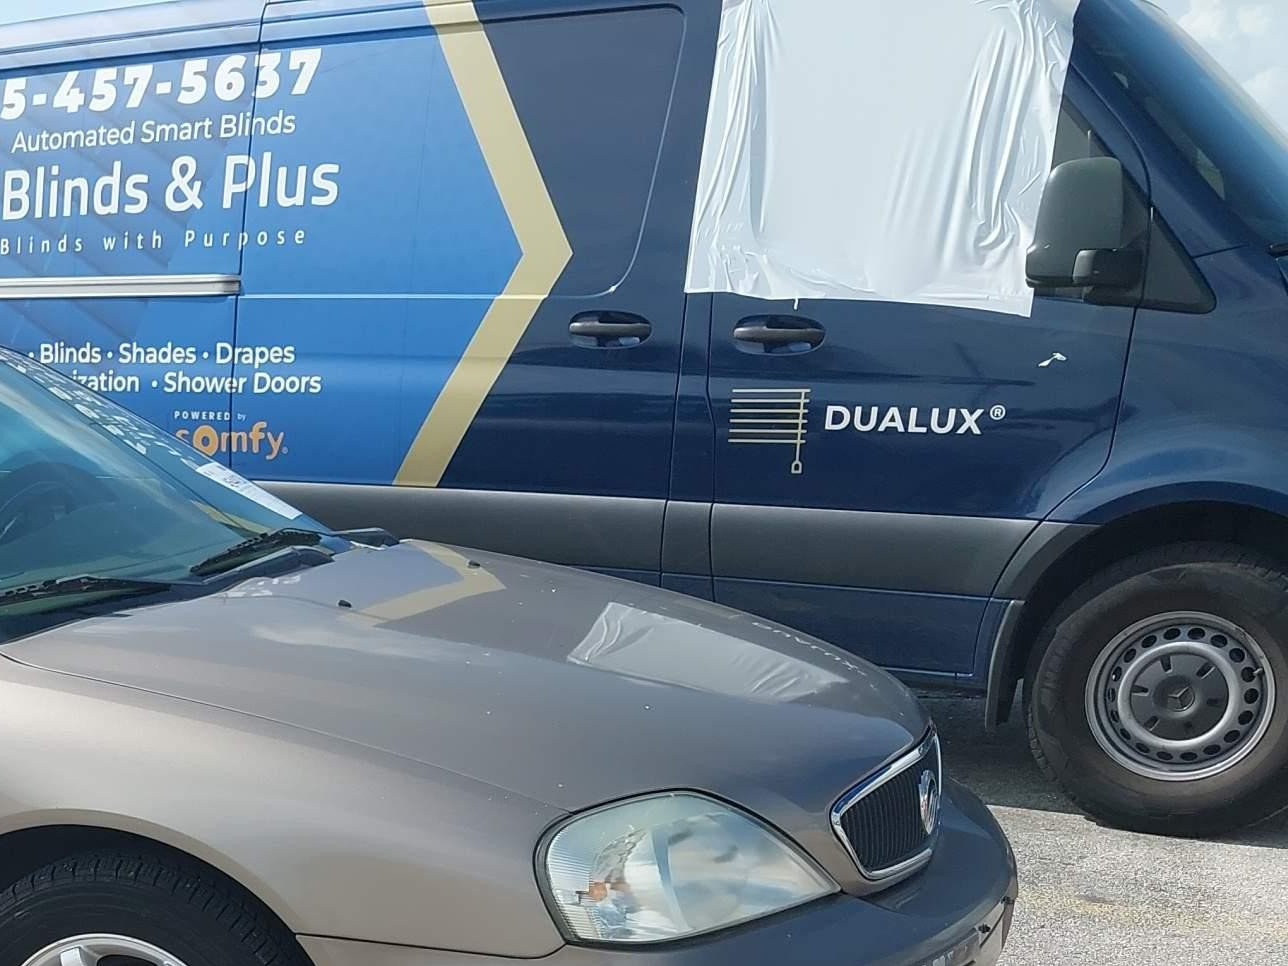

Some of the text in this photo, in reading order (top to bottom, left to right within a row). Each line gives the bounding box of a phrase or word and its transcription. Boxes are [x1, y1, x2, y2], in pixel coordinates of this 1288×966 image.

[11, 109, 296, 154] Automated Smart Blinds
[1, 151, 341, 221] Blinds & Plus
[0, 227, 305, 256] Blinds with Purpose
[39, 342, 295, 369] Blinds Shades Drapes
[71, 370, 322, 394] ization Shower Doors
[174, 410, 247, 421] POWERED by
